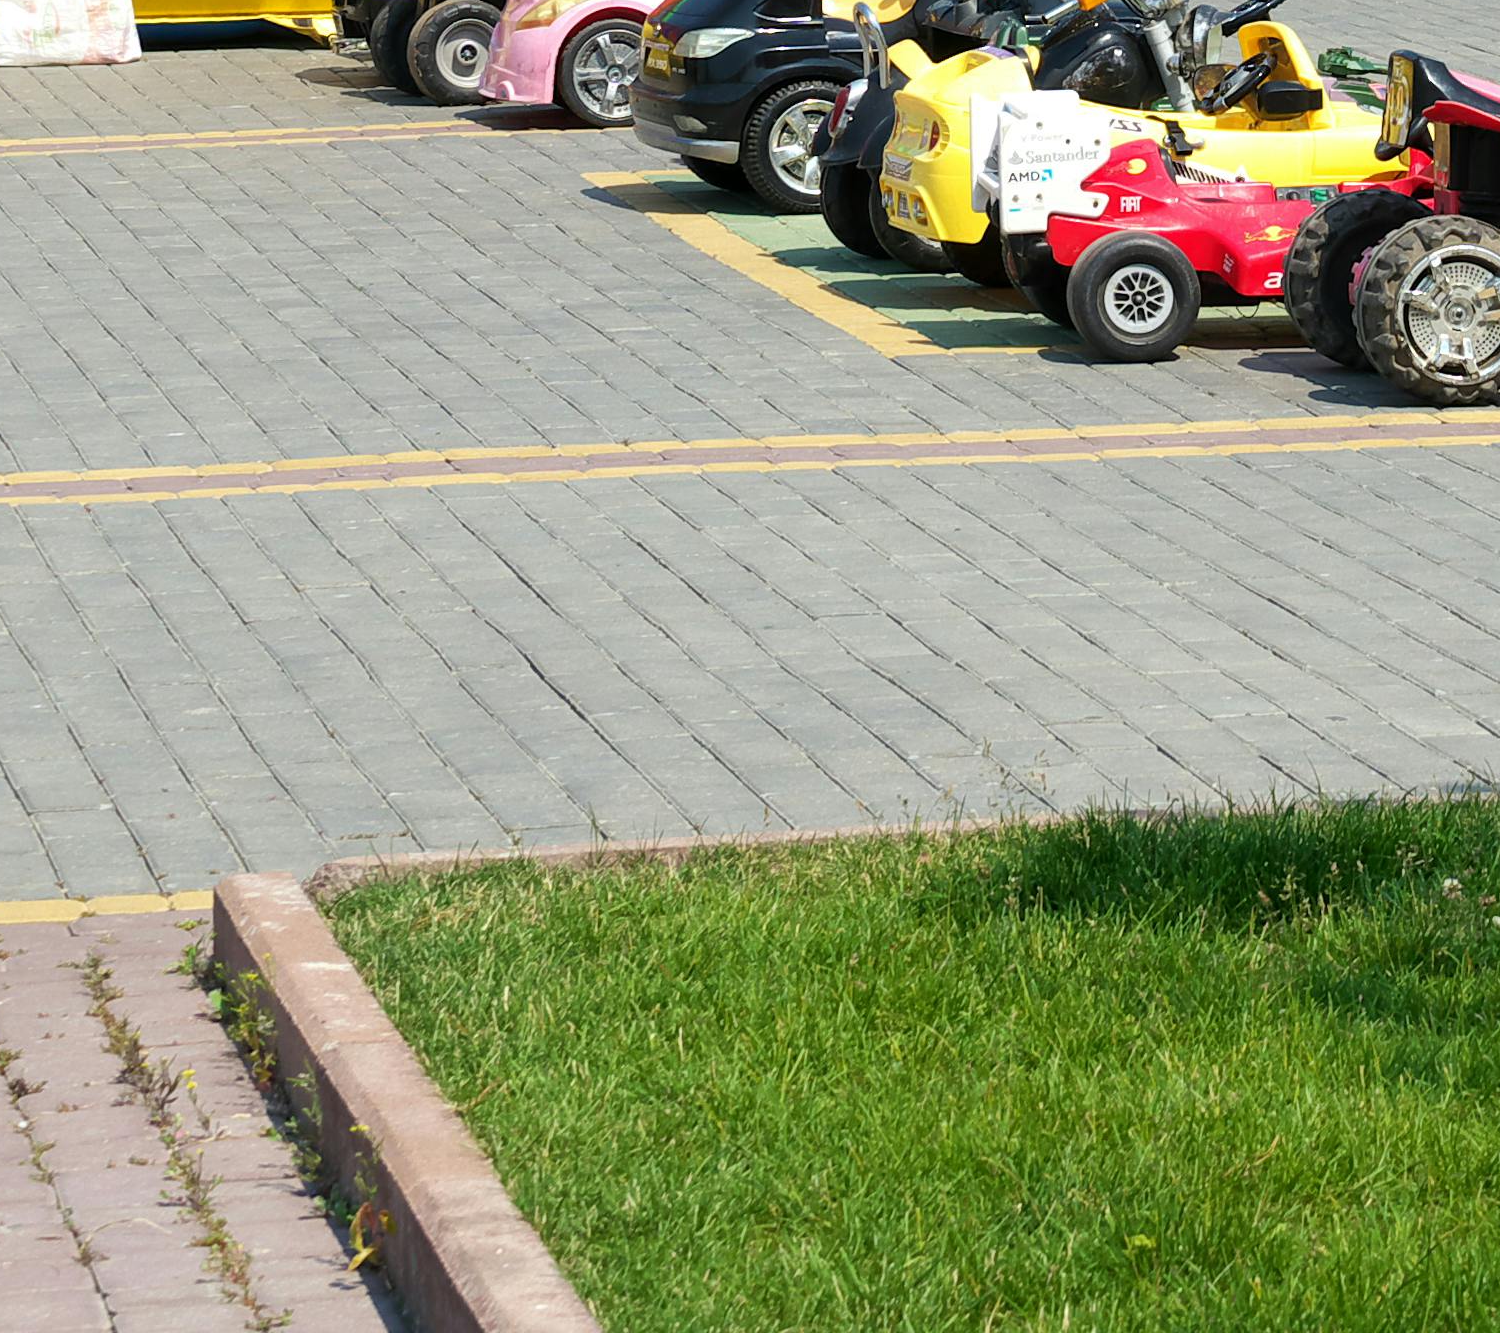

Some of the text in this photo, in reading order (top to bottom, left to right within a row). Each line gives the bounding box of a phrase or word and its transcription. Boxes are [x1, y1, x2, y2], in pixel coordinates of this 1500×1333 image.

[1025, 146, 1100, 165] Santander
[1008, 171, 1040, 183] AMD
[1119, 196, 1143, 213] FIAT
